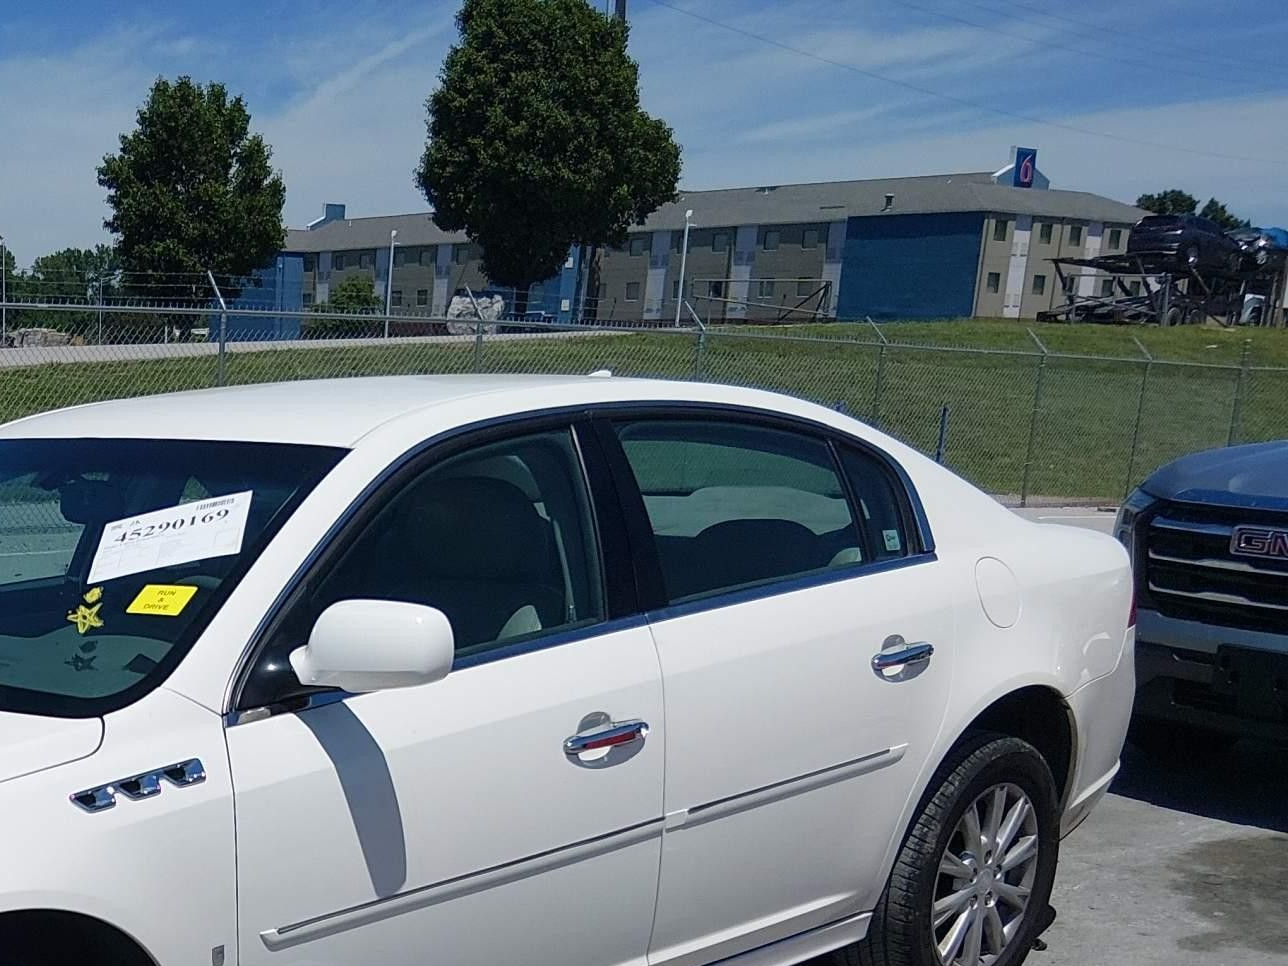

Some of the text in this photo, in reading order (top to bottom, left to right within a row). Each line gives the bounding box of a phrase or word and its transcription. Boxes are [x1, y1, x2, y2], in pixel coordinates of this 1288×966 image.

[1020, 154, 1033, 182] 6
[114, 508, 230, 543] 45290169
[143, 603, 170, 611] DRIVE
